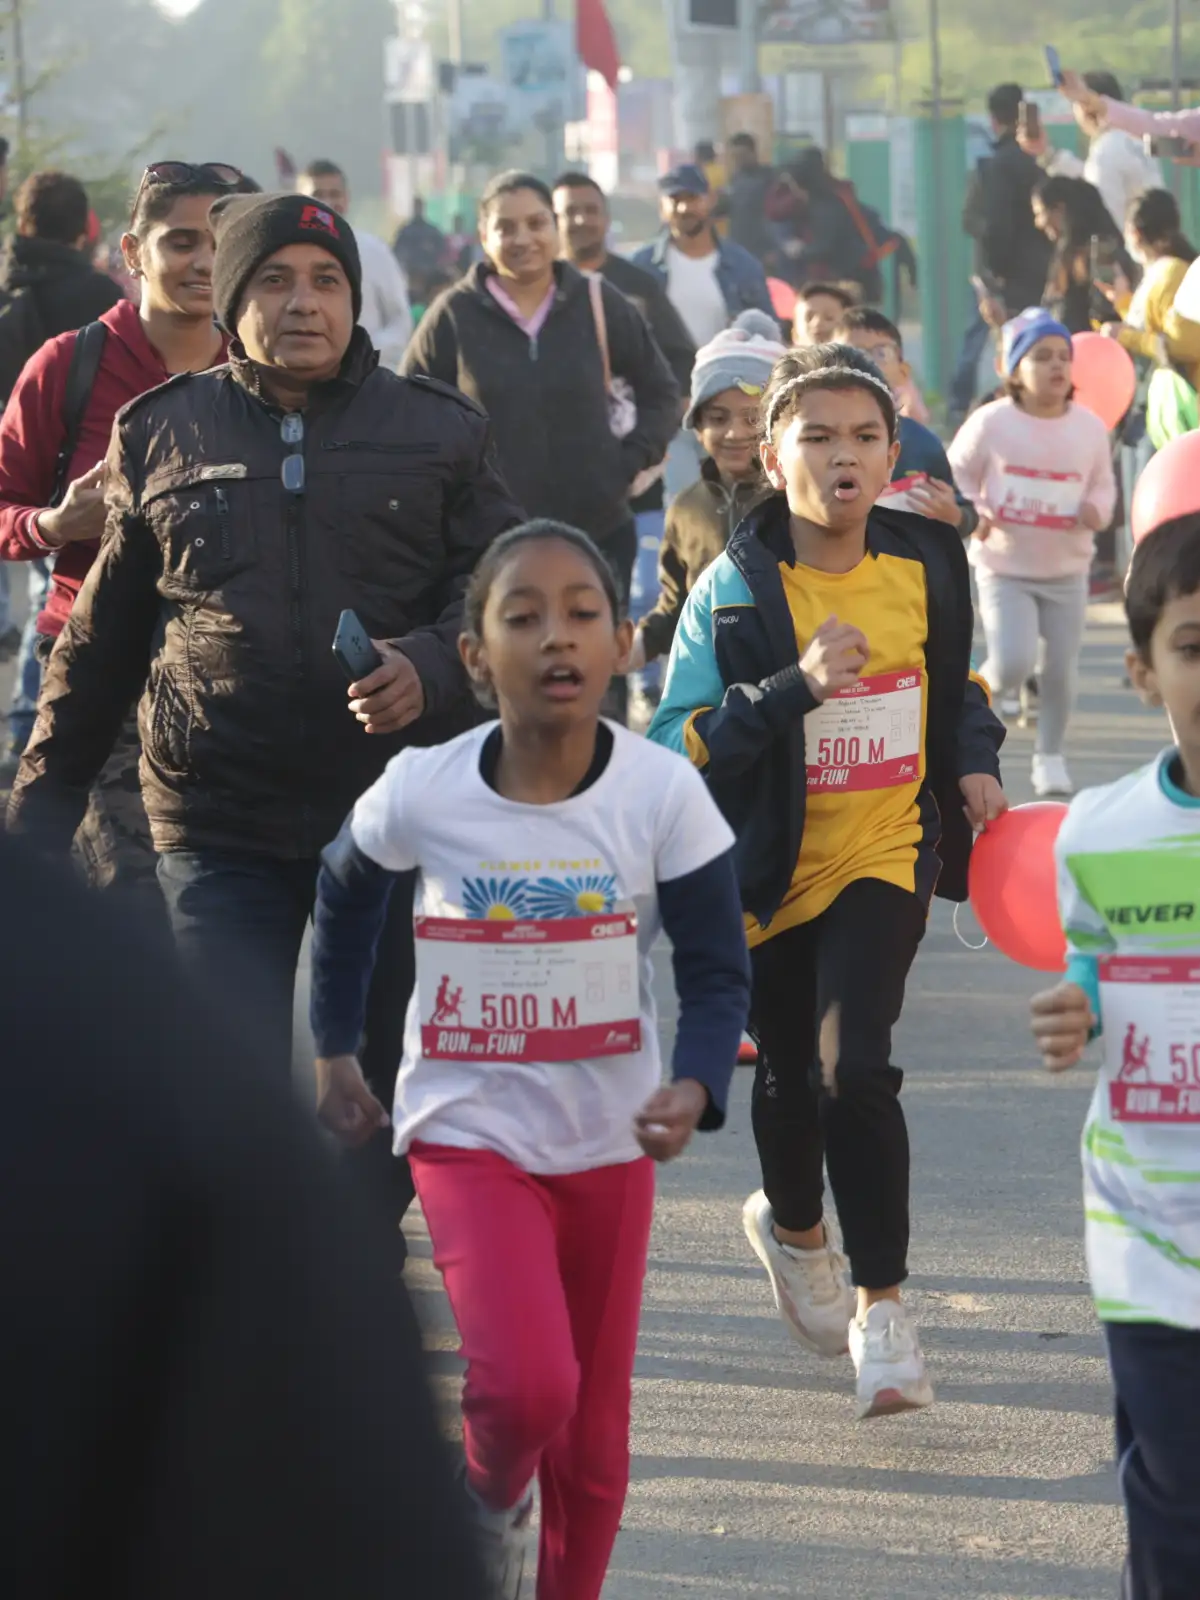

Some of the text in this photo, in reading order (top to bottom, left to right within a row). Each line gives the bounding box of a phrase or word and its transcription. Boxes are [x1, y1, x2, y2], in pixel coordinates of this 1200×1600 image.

[817, 737, 885, 767] 500 M
[820, 768, 850, 785] FUN!
[481, 994, 578, 1030] 500 M
[437, 1031, 471, 1053] RUN
[486, 1033, 526, 1055] FUN!
